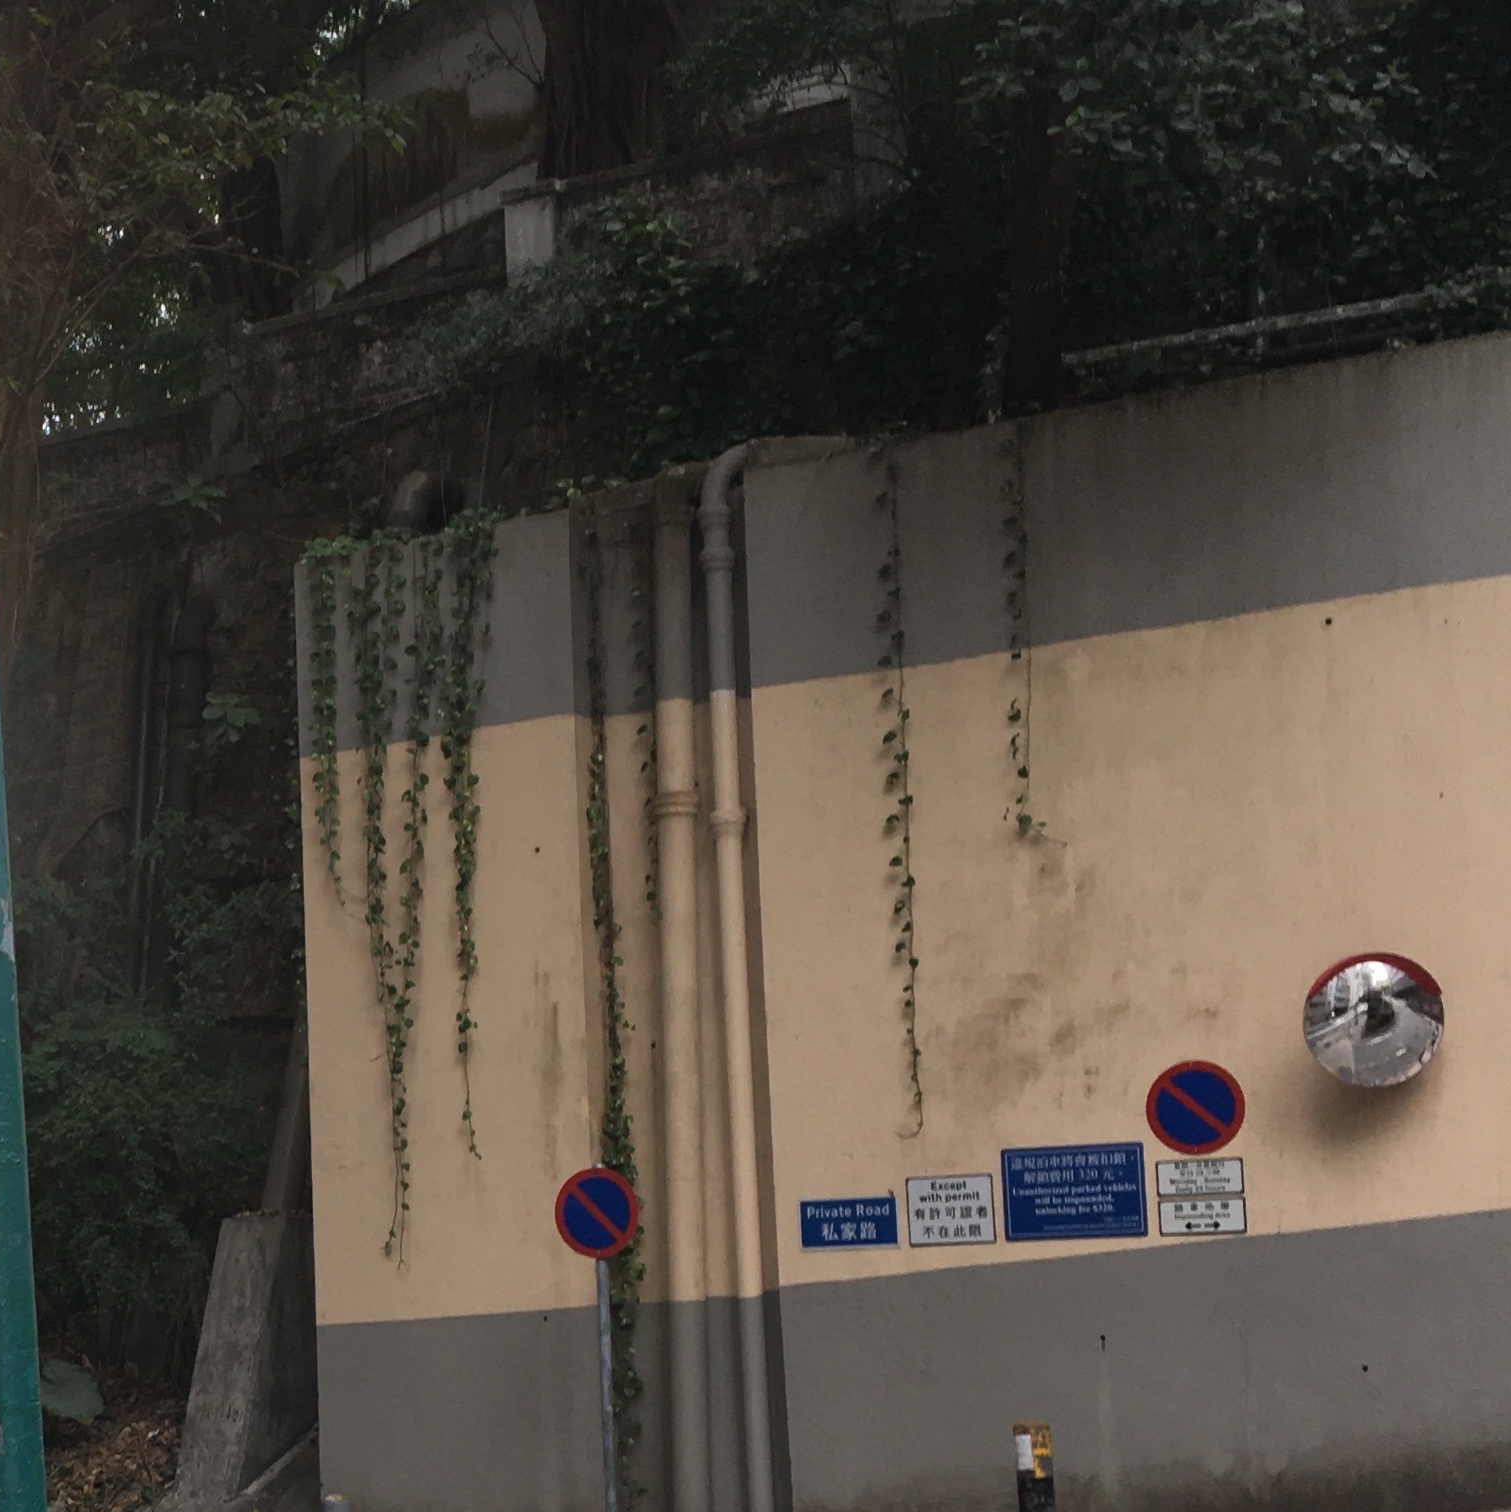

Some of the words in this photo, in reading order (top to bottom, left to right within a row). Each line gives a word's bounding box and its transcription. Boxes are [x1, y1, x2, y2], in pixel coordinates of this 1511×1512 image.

[930, 1180, 967, 1193] Except
[919, 1192, 942, 1203] with
[945, 1190, 980, 1203] permit
[807, 1204, 852, 1219] Private
[856, 1202, 890, 1217] Road
[914, 1205, 989, 1221] 有許可證者
[821, 1221, 877, 1241] 私家路
[922, 1223, 982, 1239] 不在此限
